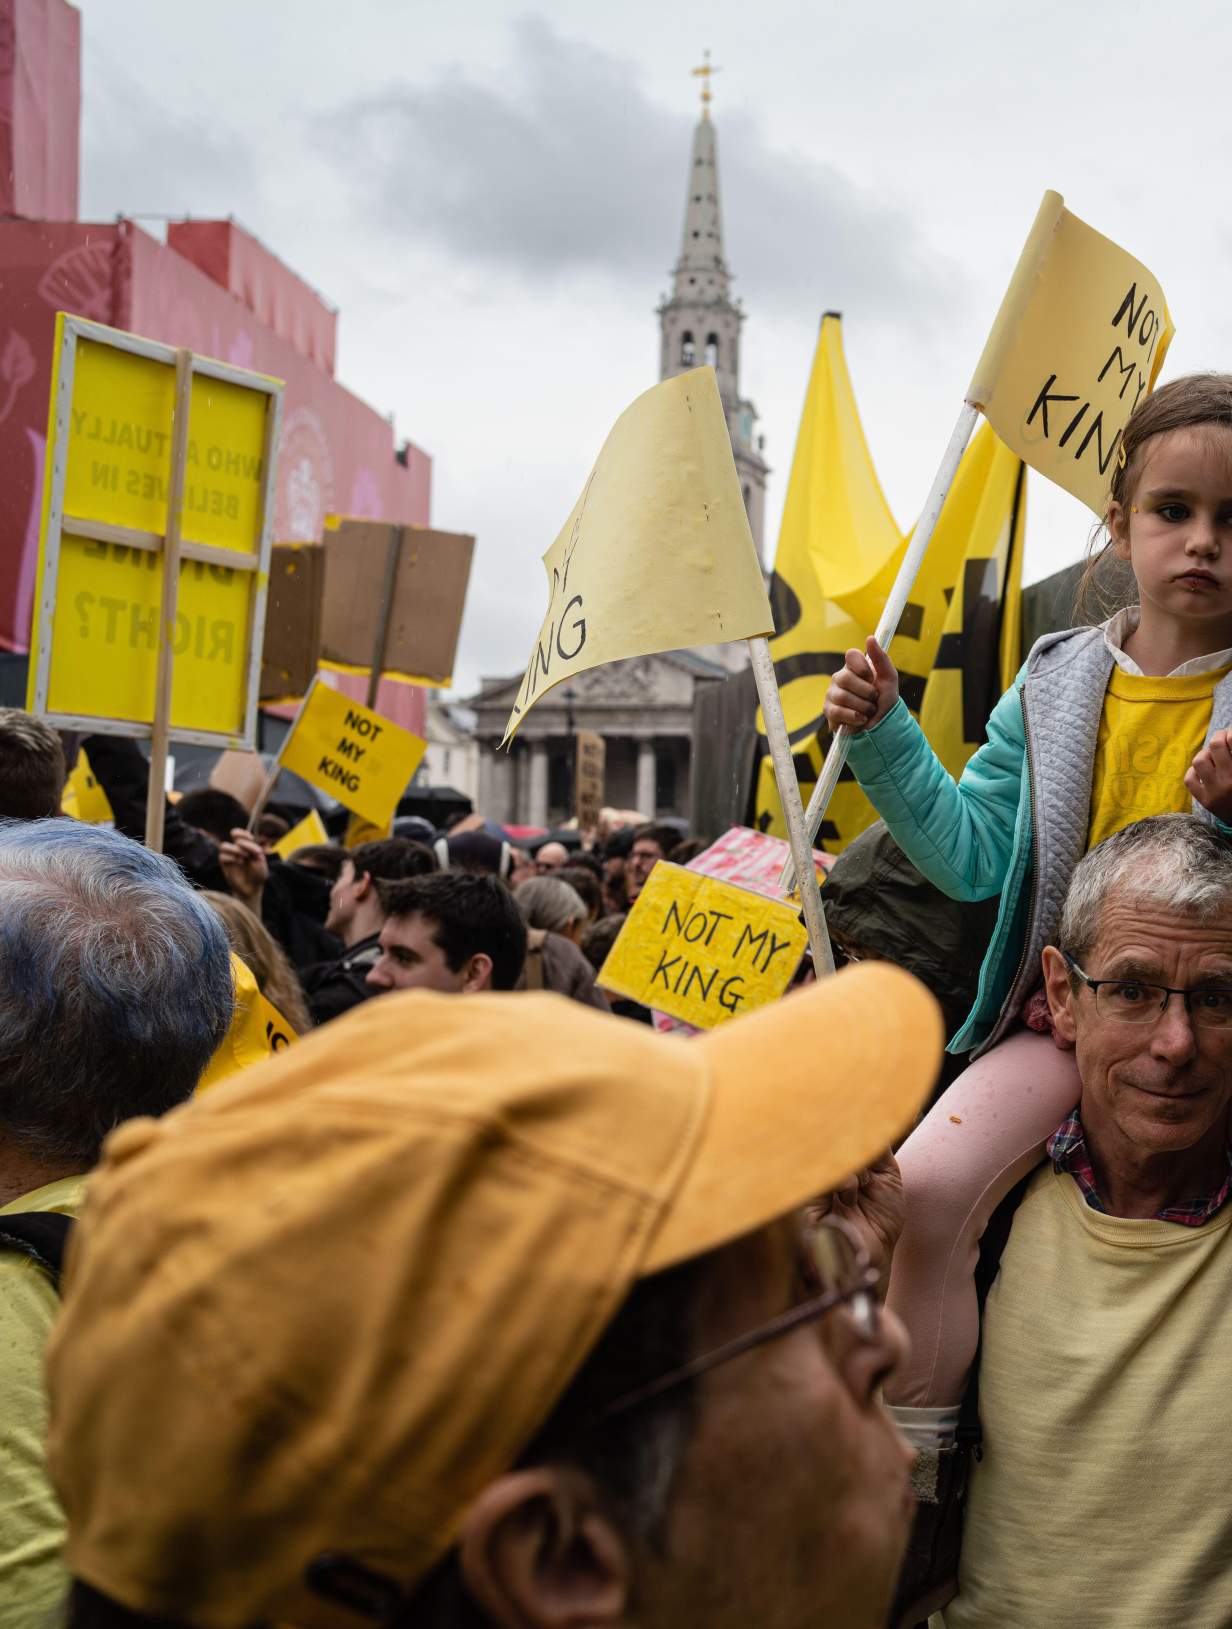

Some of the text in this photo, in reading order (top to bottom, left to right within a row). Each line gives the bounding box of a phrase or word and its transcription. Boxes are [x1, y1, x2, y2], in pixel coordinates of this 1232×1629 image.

[1097, 346, 1146, 416] MY
[1026, 374, 1123, 475] KIN
[514, 595, 586, 714] ING
[336, 737, 366, 763] MY
[344, 709, 383, 742] NOT
[317, 755, 361, 792] KING
[662, 900, 791, 973] NOT MY
[650, 950, 745, 1013] KING
